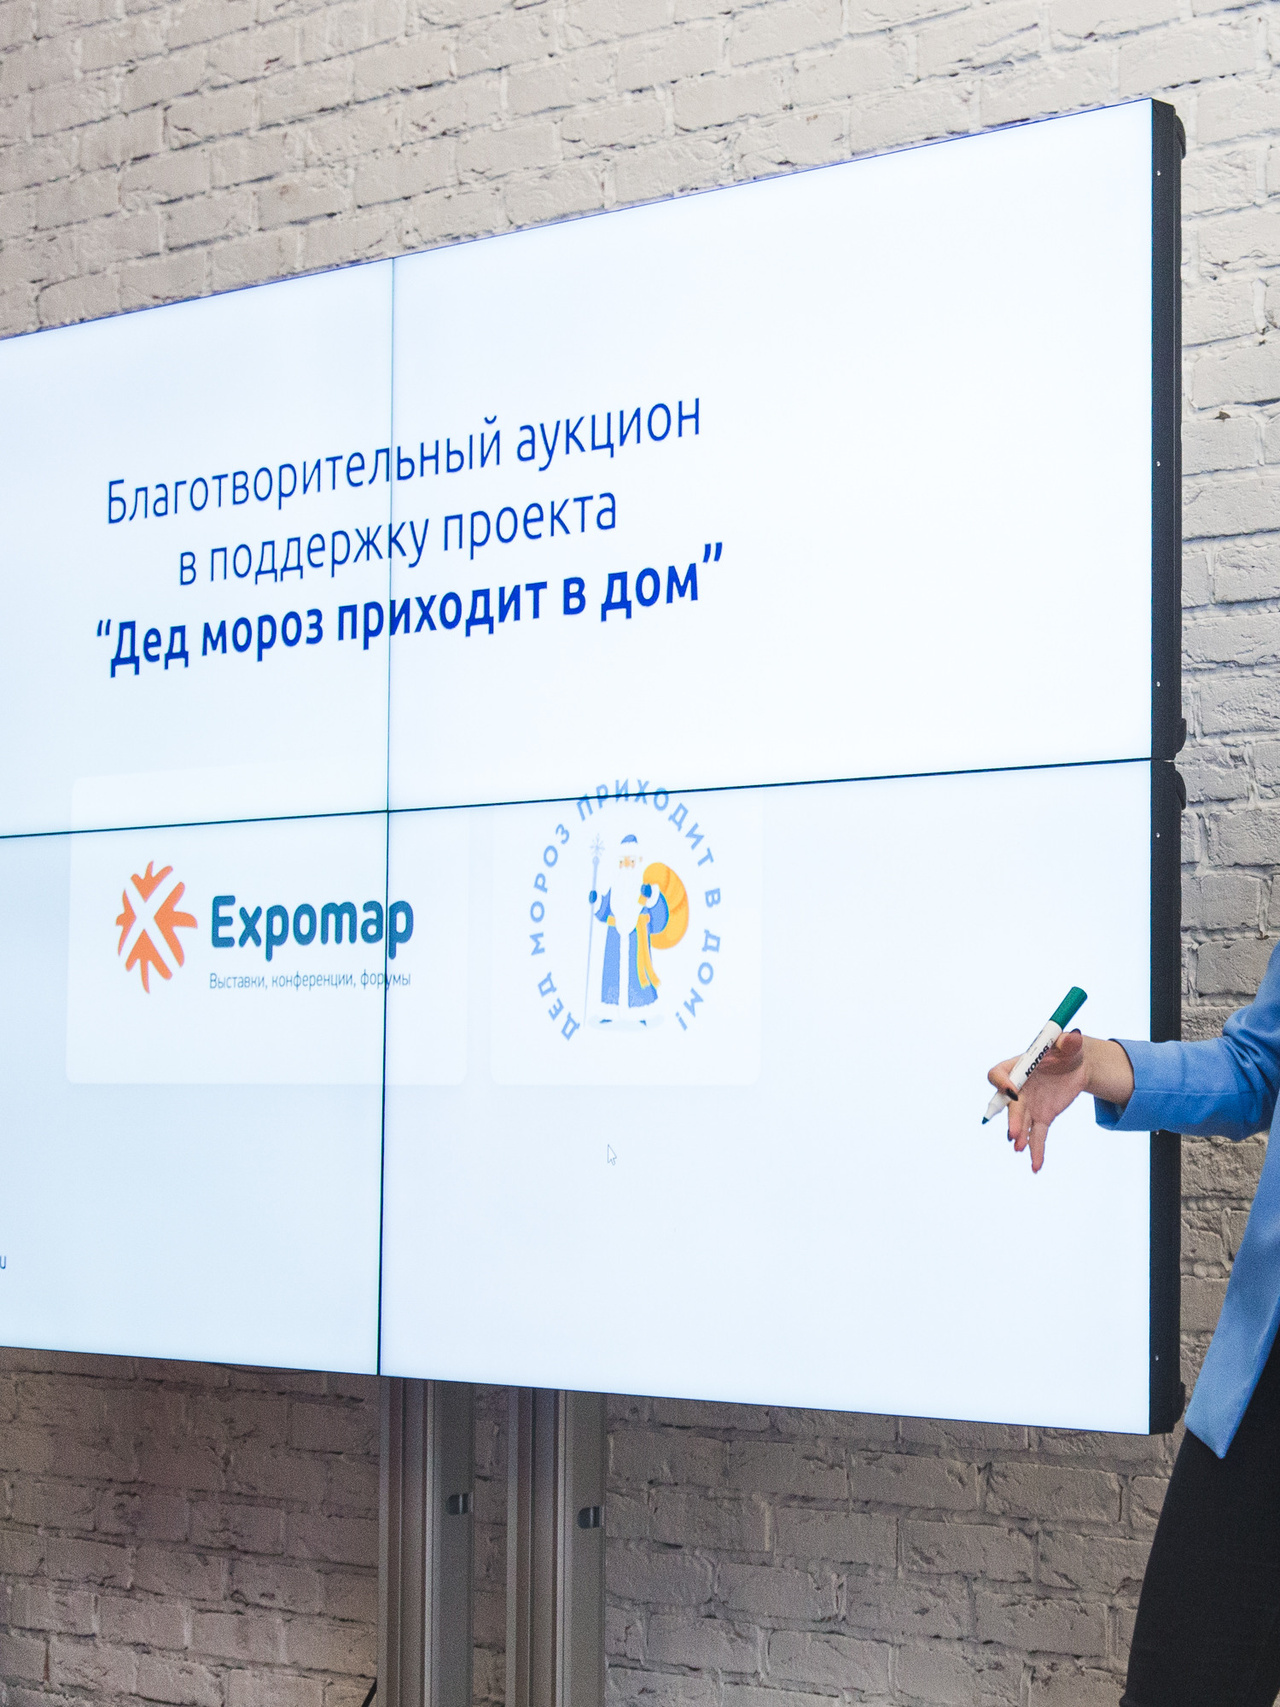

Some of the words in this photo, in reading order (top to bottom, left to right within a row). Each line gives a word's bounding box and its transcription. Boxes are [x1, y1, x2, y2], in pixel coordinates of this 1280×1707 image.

[106, 412, 503, 525] Благотворительный
[515, 397, 702, 472] аукцион
[179, 549, 197, 586] в
[209, 517, 430, 585] поддержку
[443, 491, 618, 560] проекта
[201, 605, 324, 662] мороз
[337, 580, 548, 651] приходит
[562, 576, 587, 616] в
[576, 778, 715, 868] ПРИХОДИТ
[211, 895, 415, 962] Expomap
[529, 823, 570, 956] МОРОЗ
[704, 887, 722, 908] В
[209, 972, 268, 990] Выставки,
[271, 970, 357, 991] конференции,
[360, 969, 412, 991] форумы
[537, 972, 581, 1041] ДЕД
